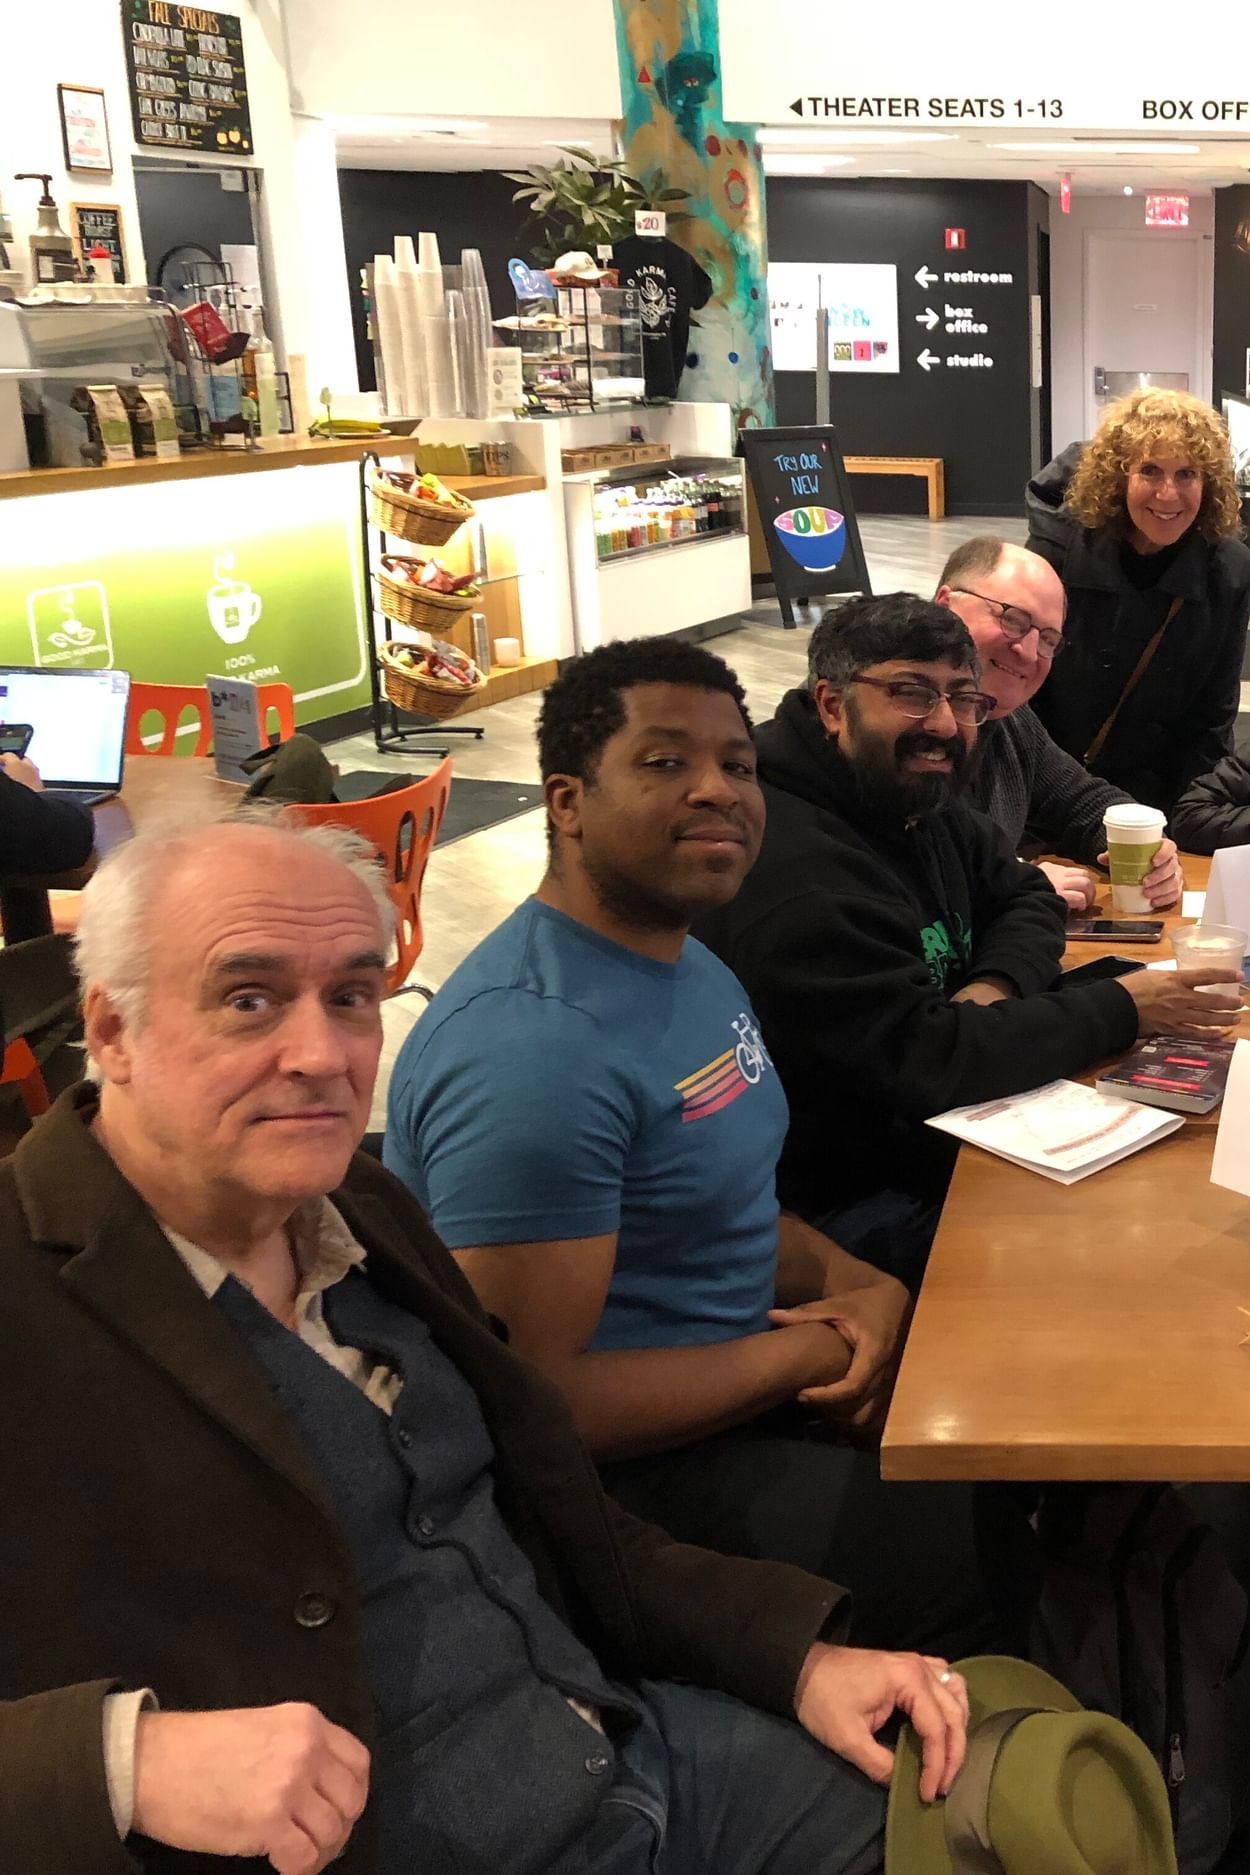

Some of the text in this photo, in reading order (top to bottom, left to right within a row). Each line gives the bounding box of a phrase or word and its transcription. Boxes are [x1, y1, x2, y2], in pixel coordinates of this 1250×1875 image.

[808, 97, 1064, 118] THEATER SEATS 1-13
[1143, 100, 1194, 120] BOX
[637, 217, 660, 230] $20
[944, 270, 1013, 283] restroom
[945, 303, 974, 318] box
[945, 319, 988, 334] office
[946, 353, 994, 367] studio
[774, 453, 823, 472] TRY OUR
[790, 475, 819, 496] NEW
[775, 508, 843, 534] SOUP
[225, 654, 256, 670] 100%
